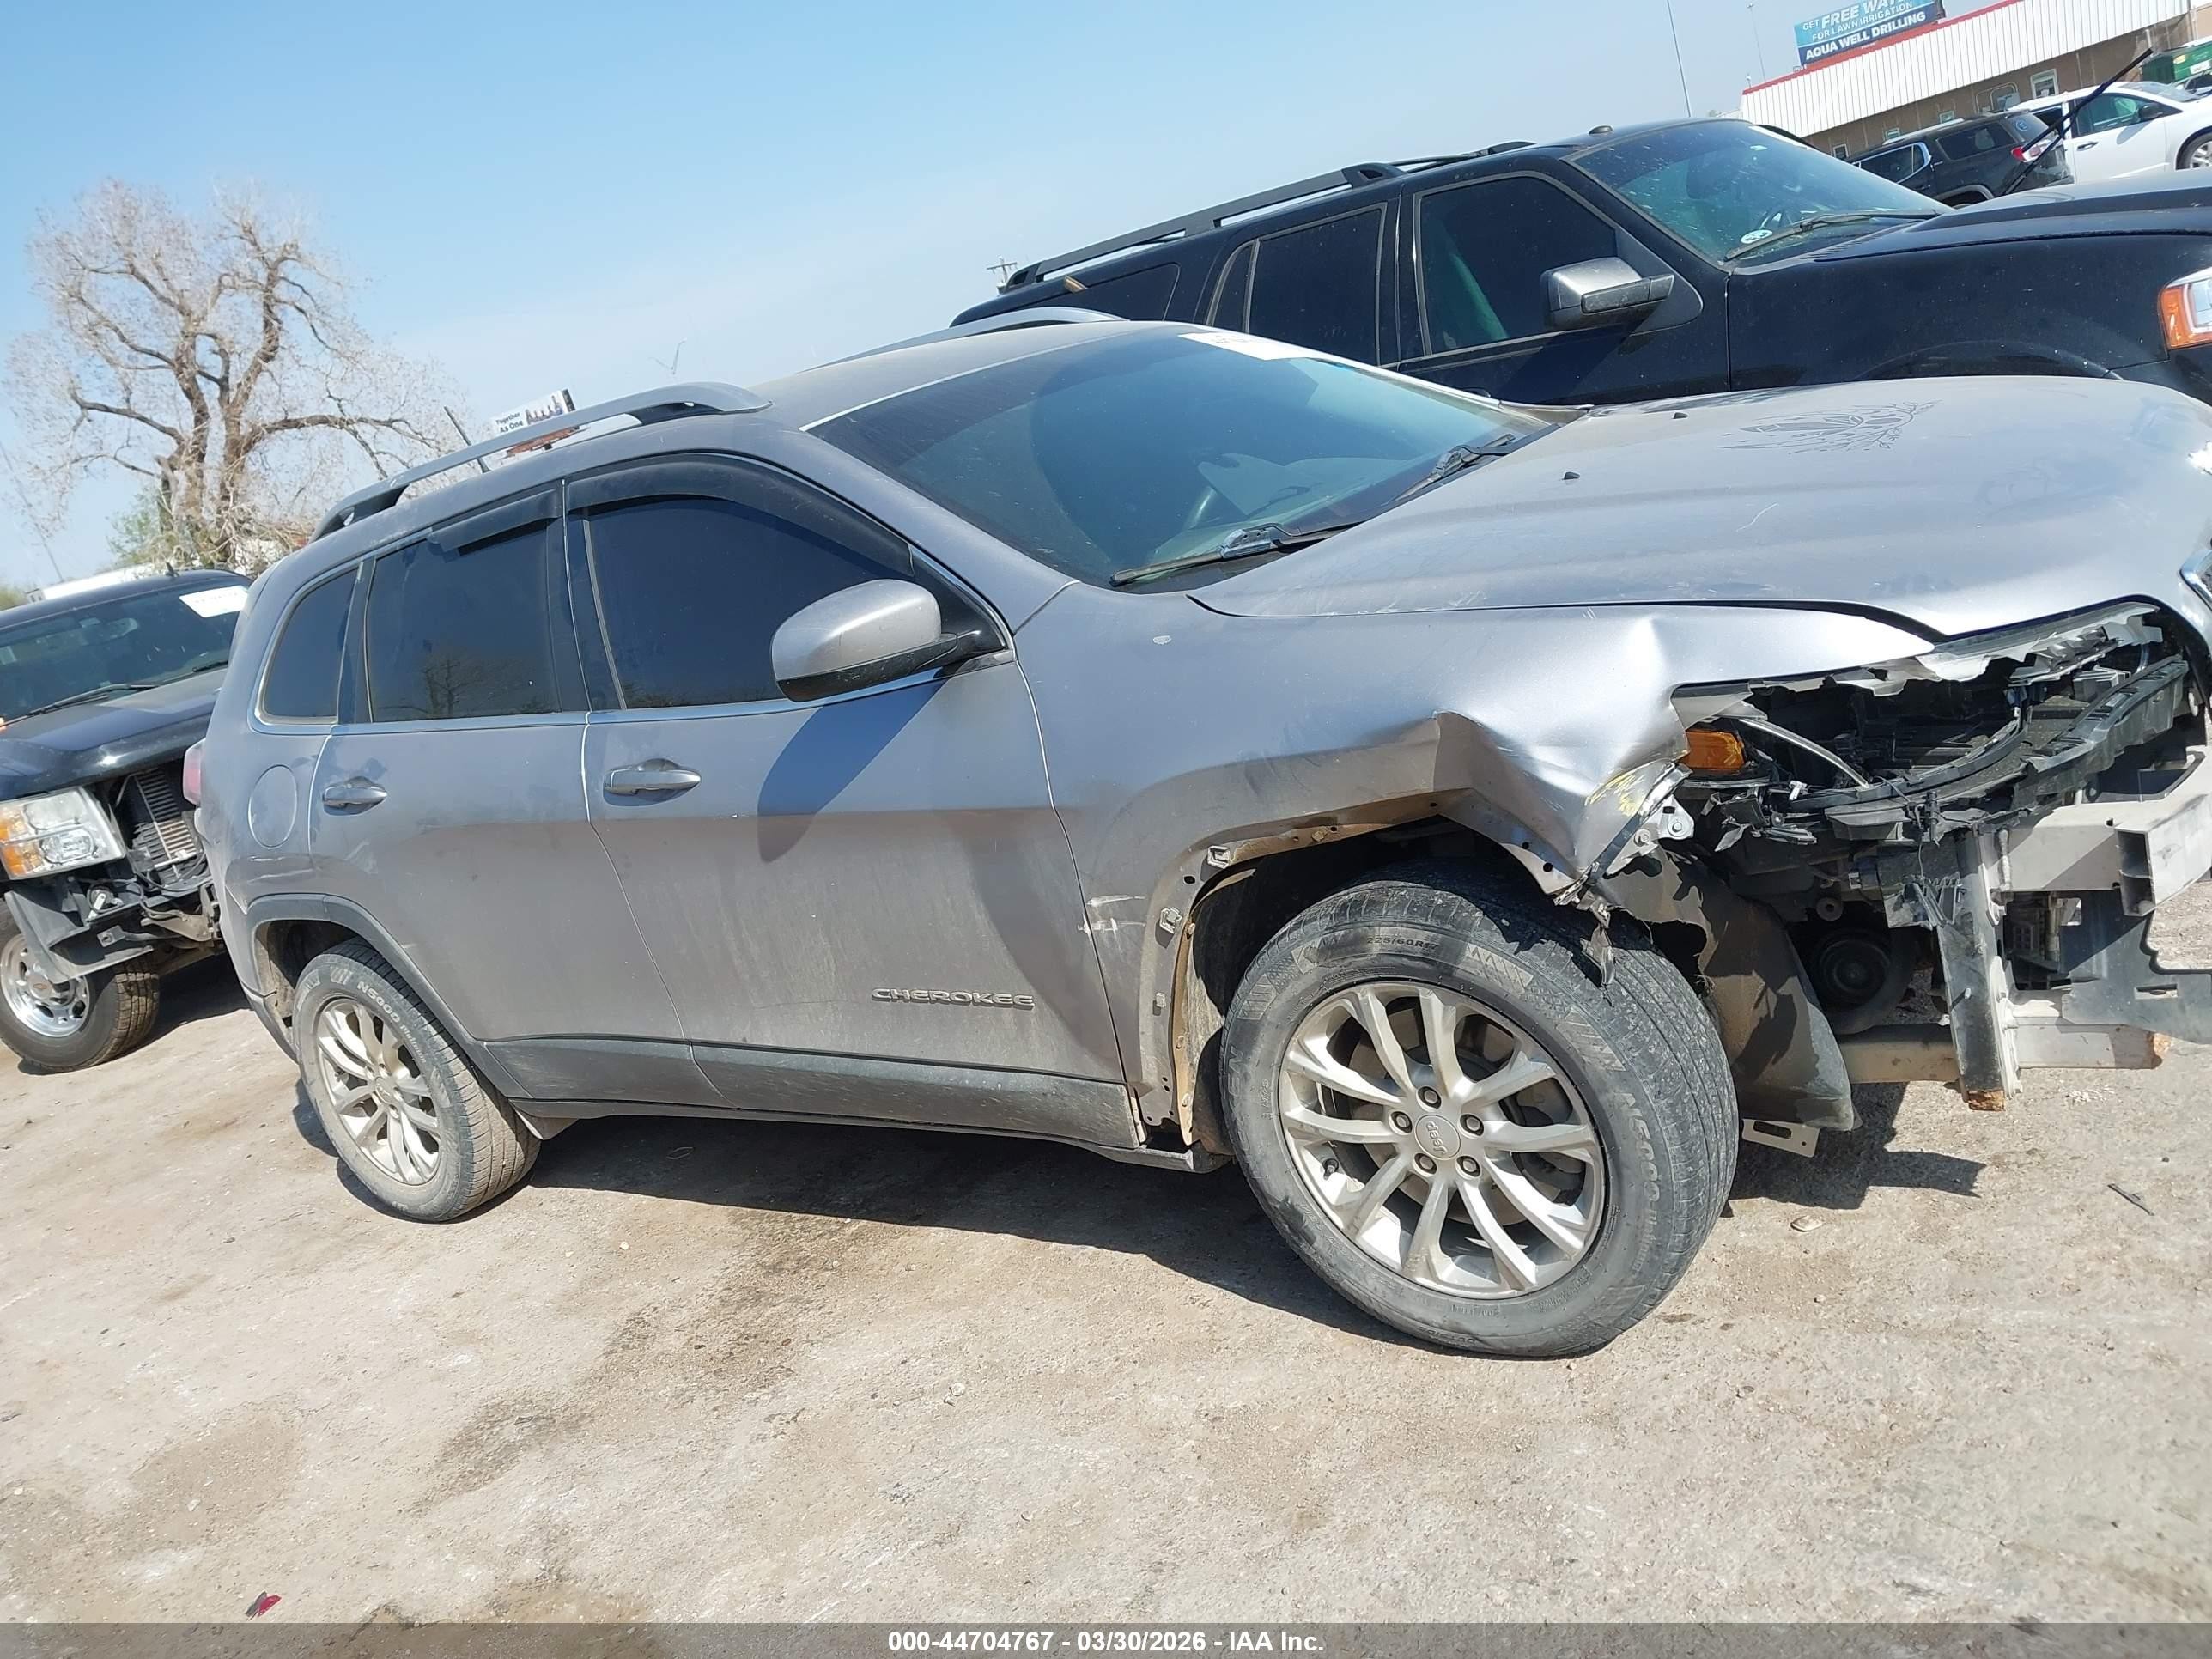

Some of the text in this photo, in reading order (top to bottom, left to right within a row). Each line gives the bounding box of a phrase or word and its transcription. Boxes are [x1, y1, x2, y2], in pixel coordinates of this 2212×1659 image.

[1802, 0, 1905, 31] GET FREE WAT
[1812, 3, 1913, 41] FOR LAWN IRRIGATION
[1805, 11, 1926, 60] AQUA WELL DRILLING
[508, 420, 524, 430] One
[357, 981, 400, 1023] N5000
[872, 988, 1035, 1011] CHEROKEE
[1426, 1120, 1449, 1155] Jeep
